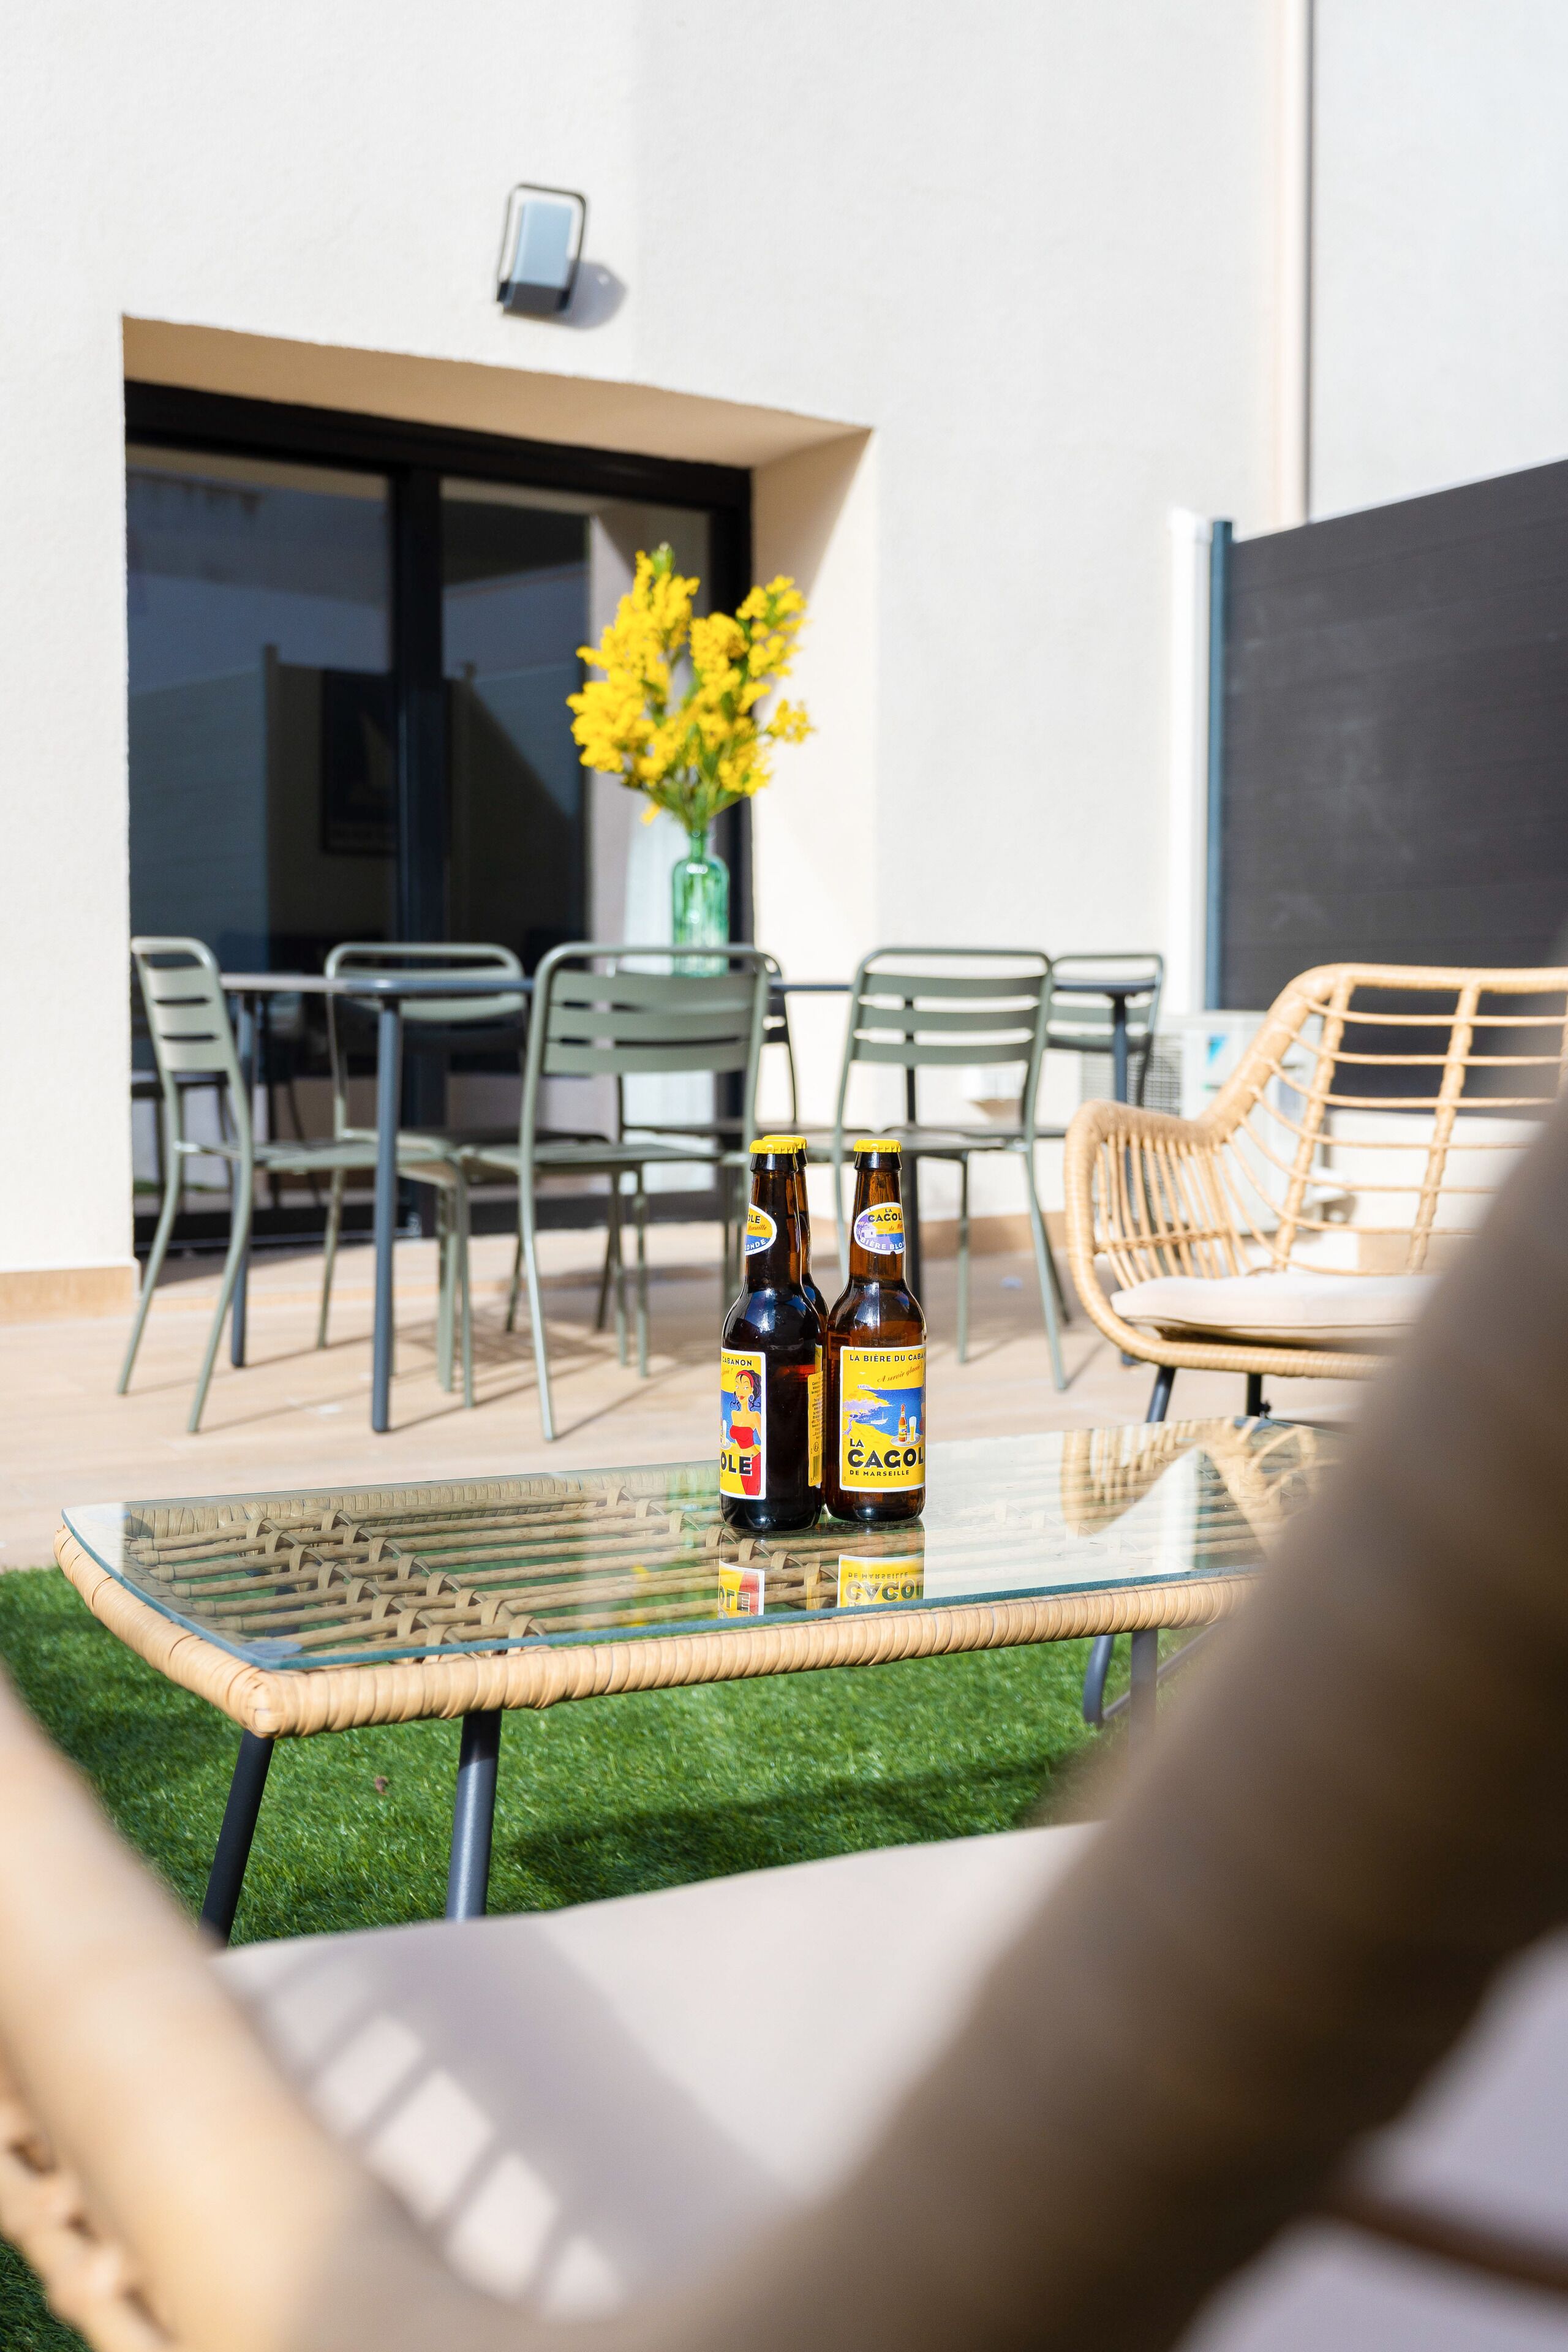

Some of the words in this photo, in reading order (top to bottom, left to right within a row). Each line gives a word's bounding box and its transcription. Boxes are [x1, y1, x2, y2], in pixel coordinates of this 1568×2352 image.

[860, 1237, 886, 1250] BIÈRE
[850, 1438, 864, 1447] LA
[720, 1451, 752, 1475] OLE
[847, 1446, 924, 1468] CAGOL
